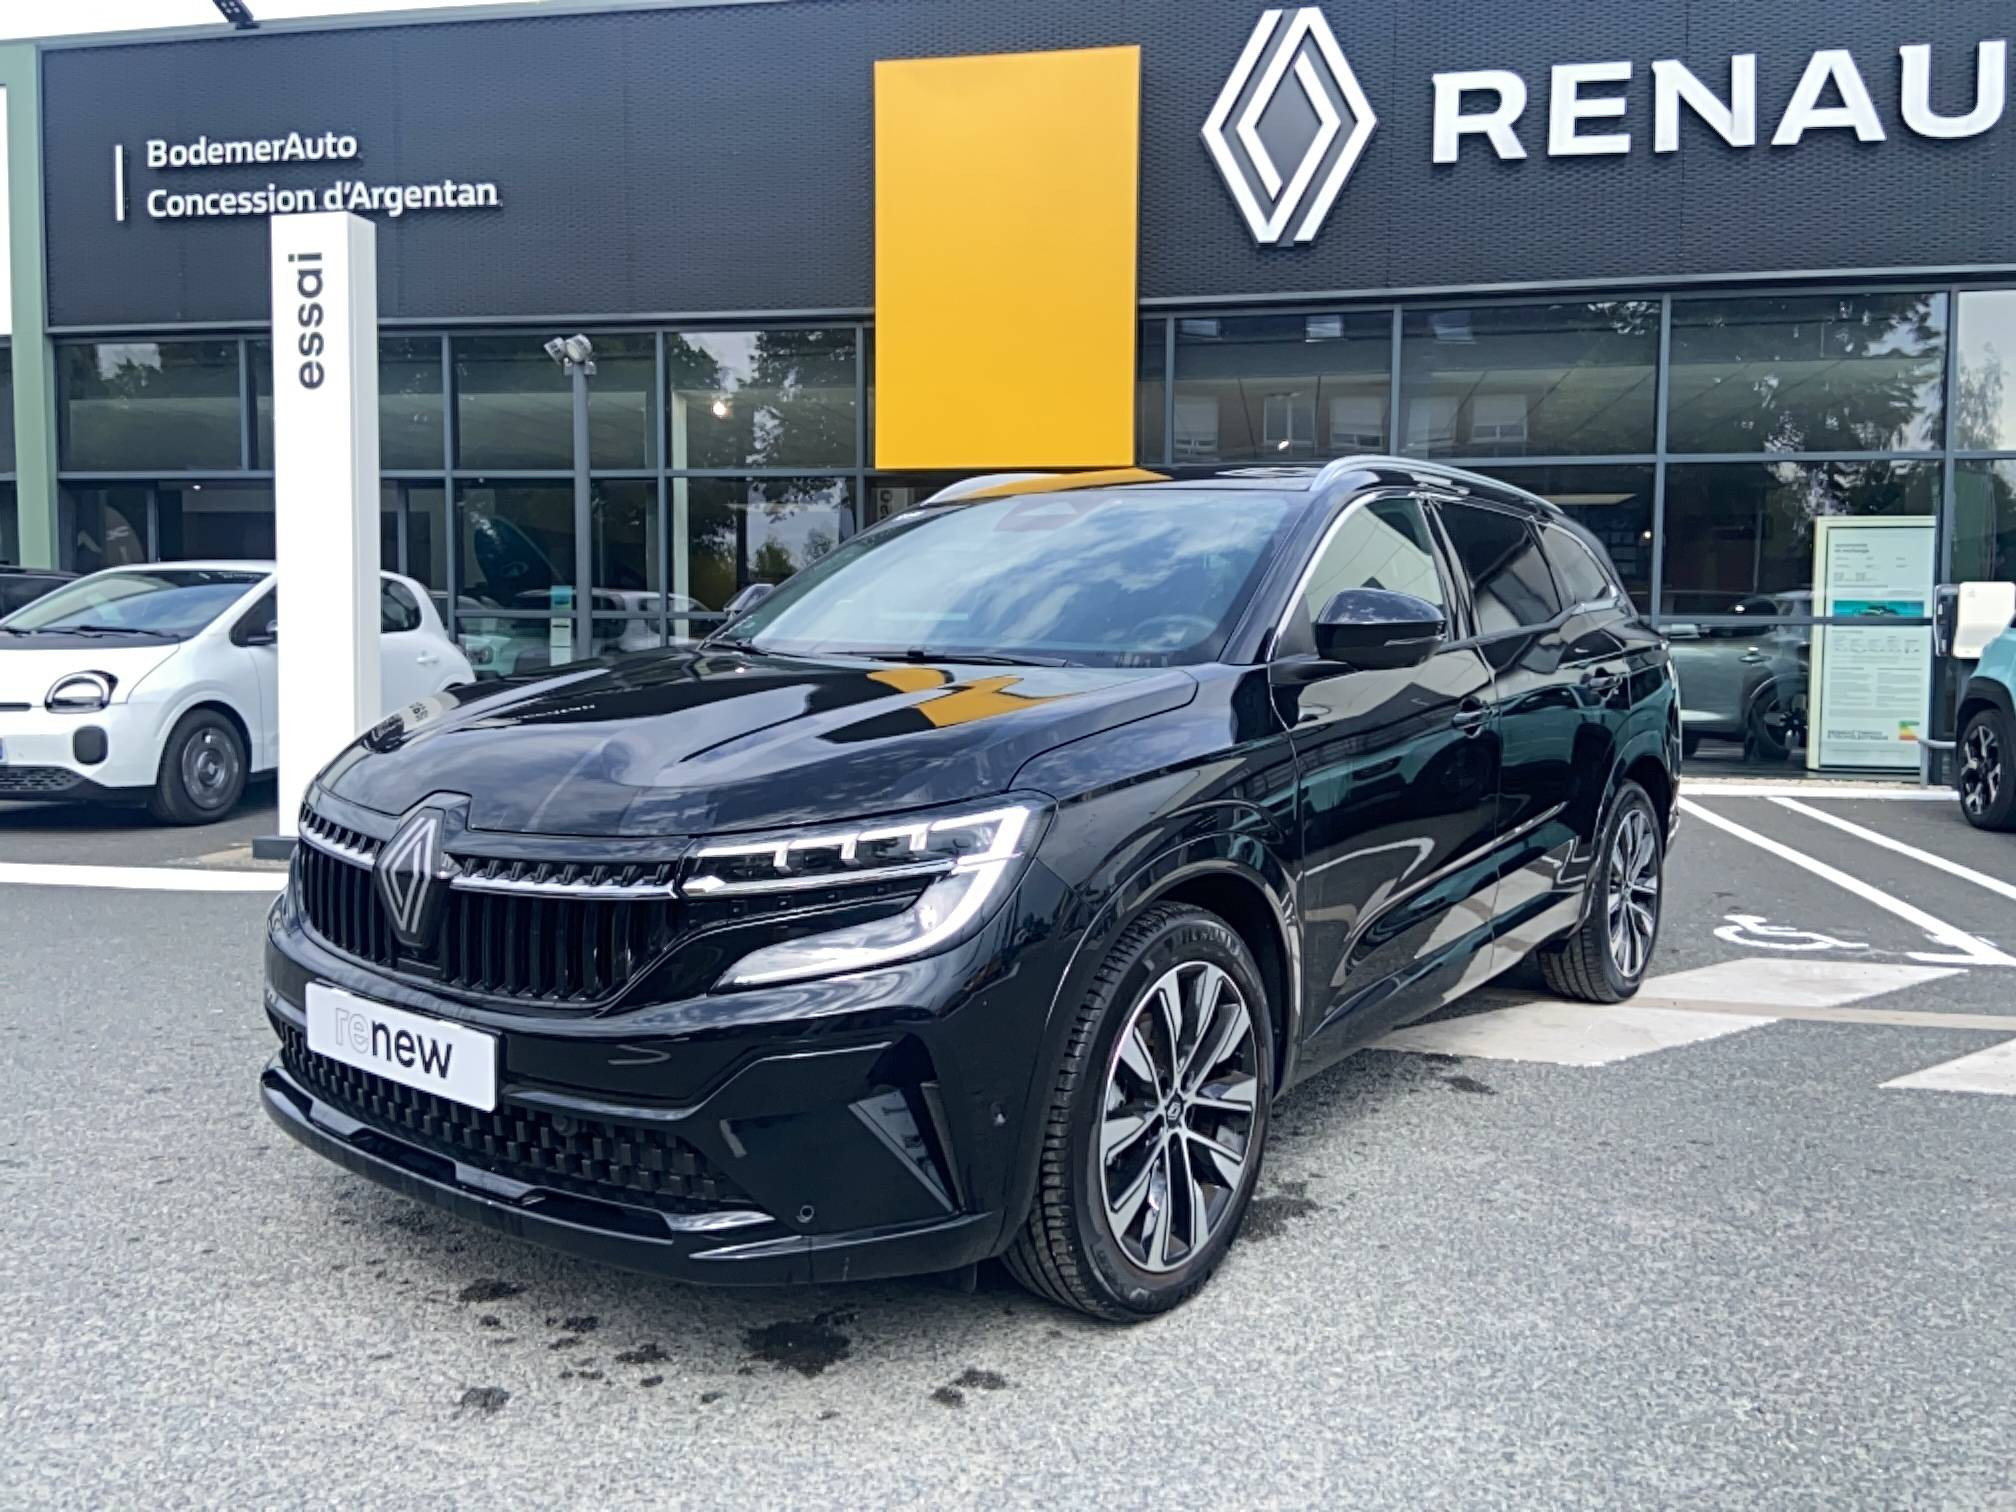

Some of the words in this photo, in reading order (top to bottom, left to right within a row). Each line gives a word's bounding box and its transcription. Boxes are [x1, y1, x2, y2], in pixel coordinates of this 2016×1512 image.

[1432, 40, 2006, 163] RENAU
[146, 131, 357, 168] BodemerAuto
[146, 184, 316, 218] Concession
[324, 179, 499, 217] d'Argentan
[288, 252, 325, 390] essai
[335, 1007, 453, 1079] renew
